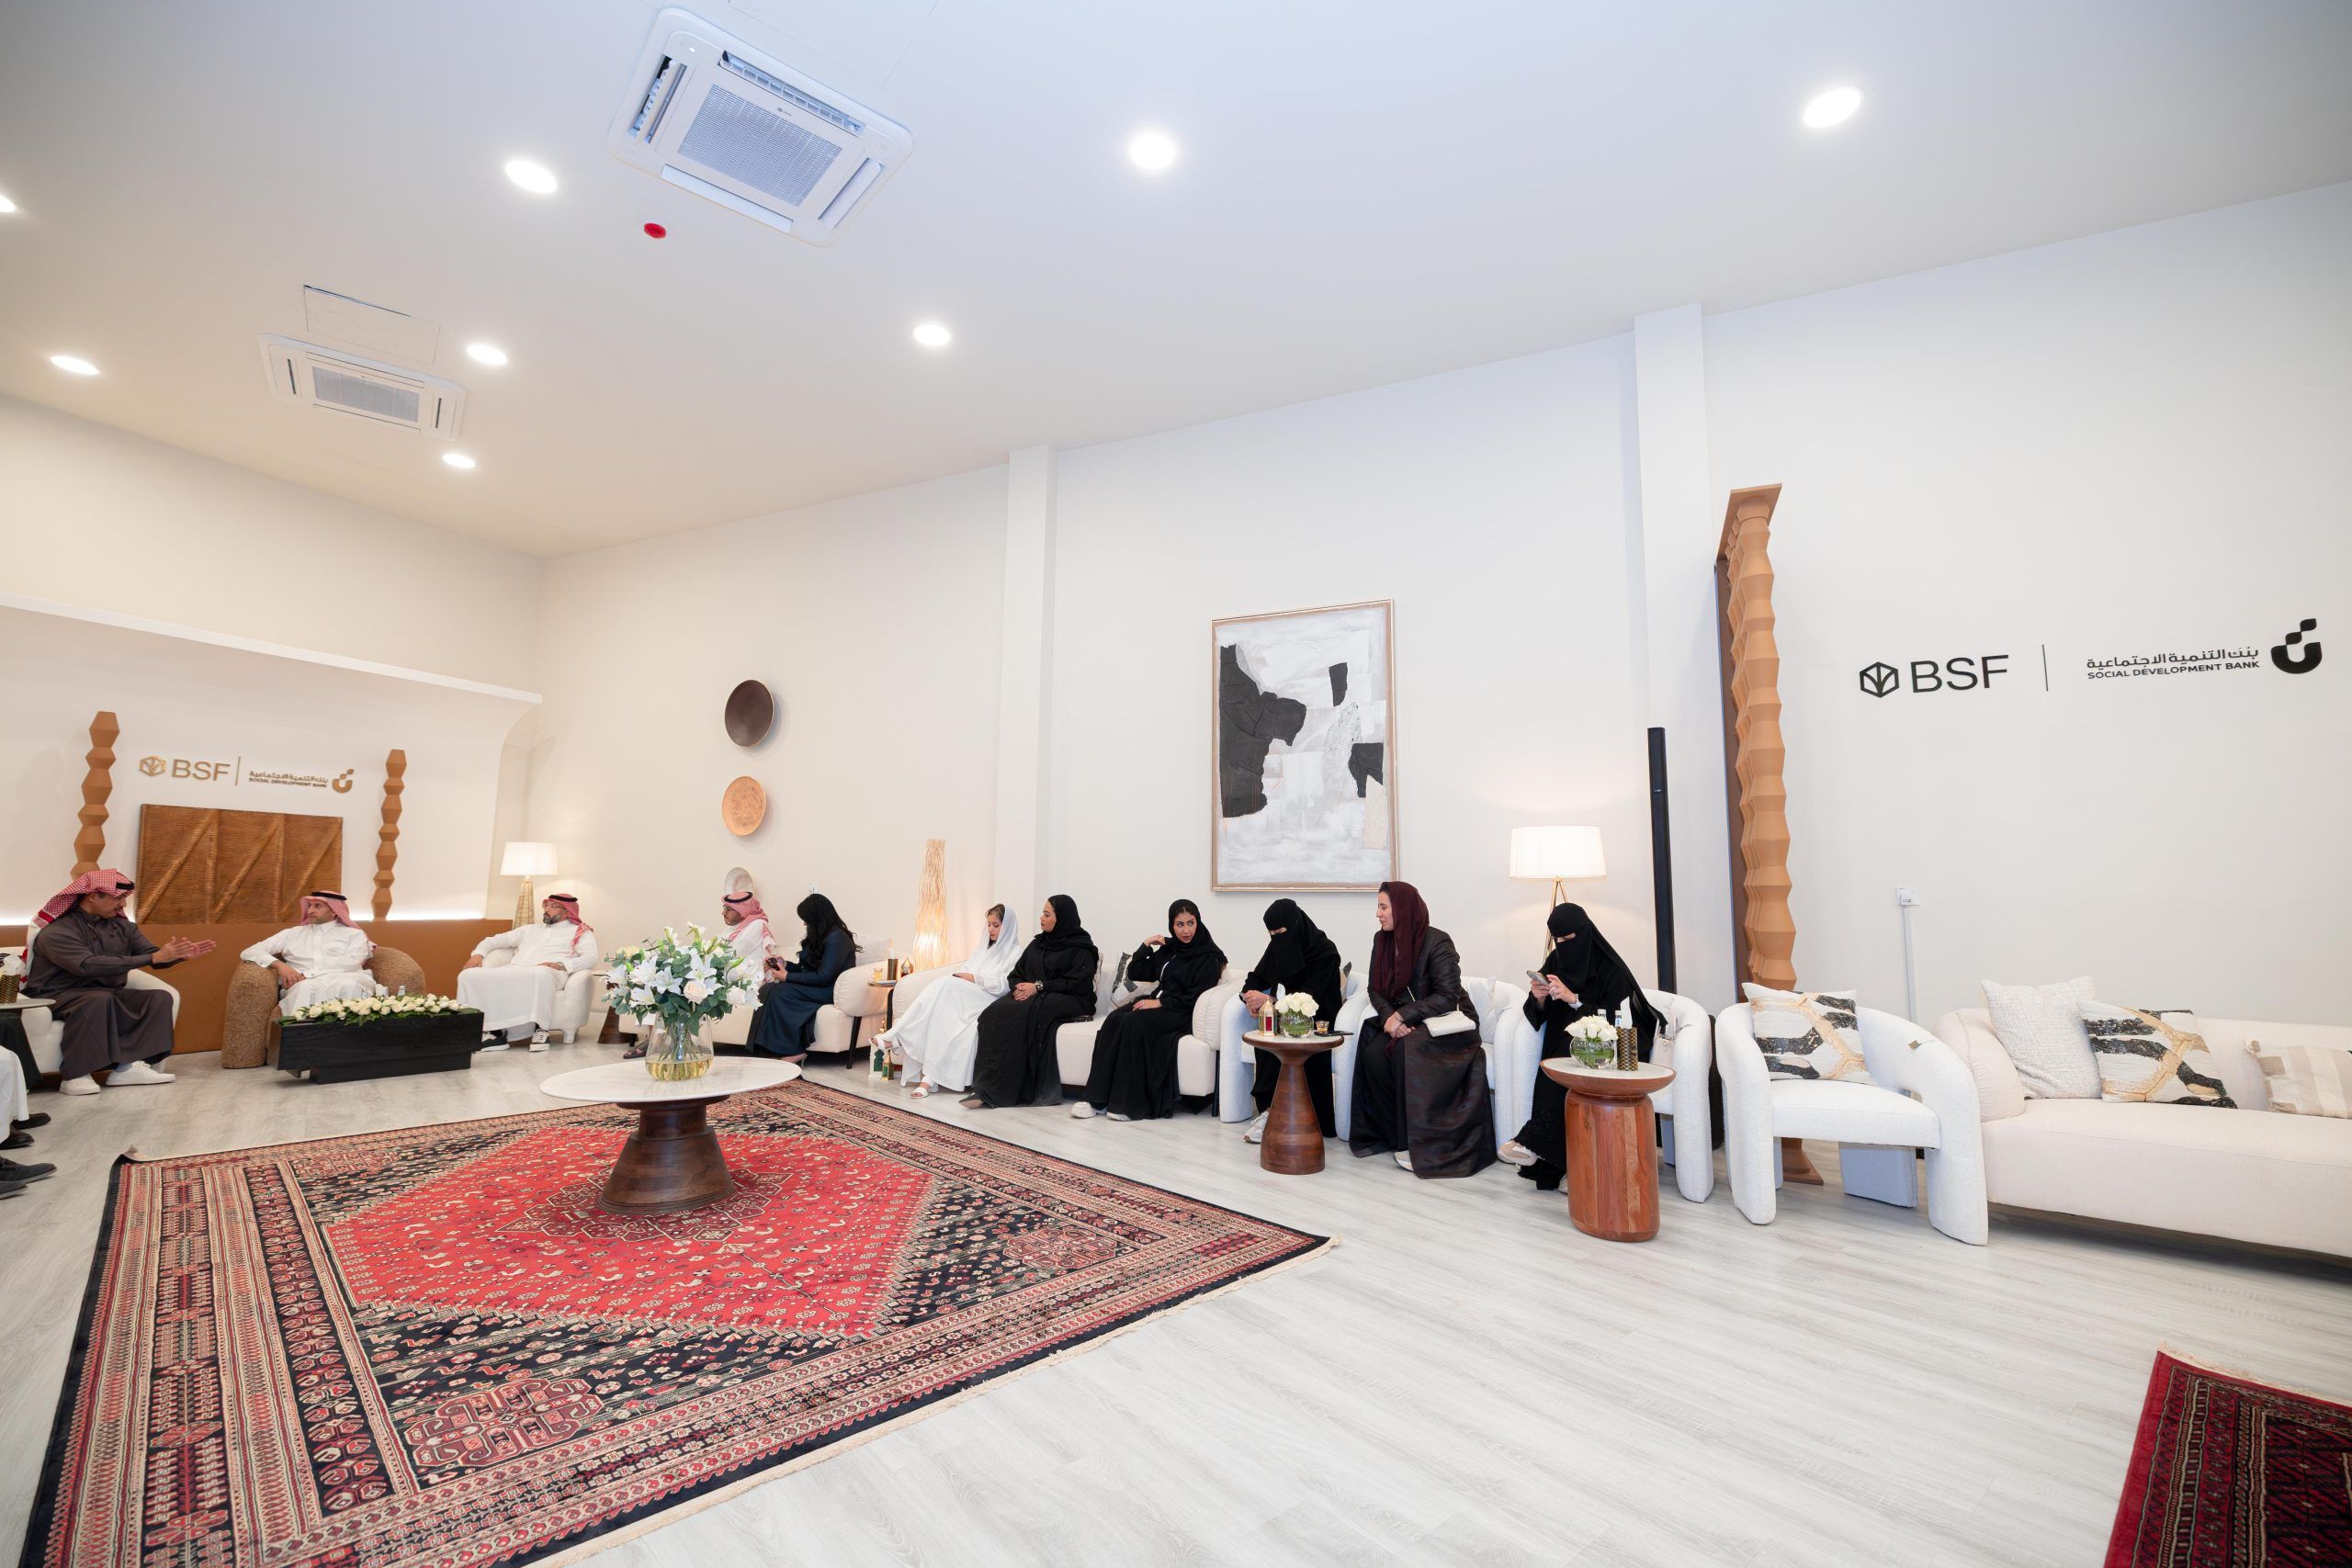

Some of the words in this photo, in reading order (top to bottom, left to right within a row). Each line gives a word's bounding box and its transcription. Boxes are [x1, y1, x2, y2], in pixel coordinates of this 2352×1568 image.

[2087, 654, 2165, 670] الاجتماعية
[2169, 649, 2225, 664] التنمية
[2228, 647, 2259, 660] بنك
[1910, 654, 2009, 693] BSF
[2087, 671, 2130, 679] SOCIAL
[2133, 663, 2222, 675] DEVELOPMENT
[2226, 660, 2260, 670] BANK
[172, 759, 231, 781] BSF
